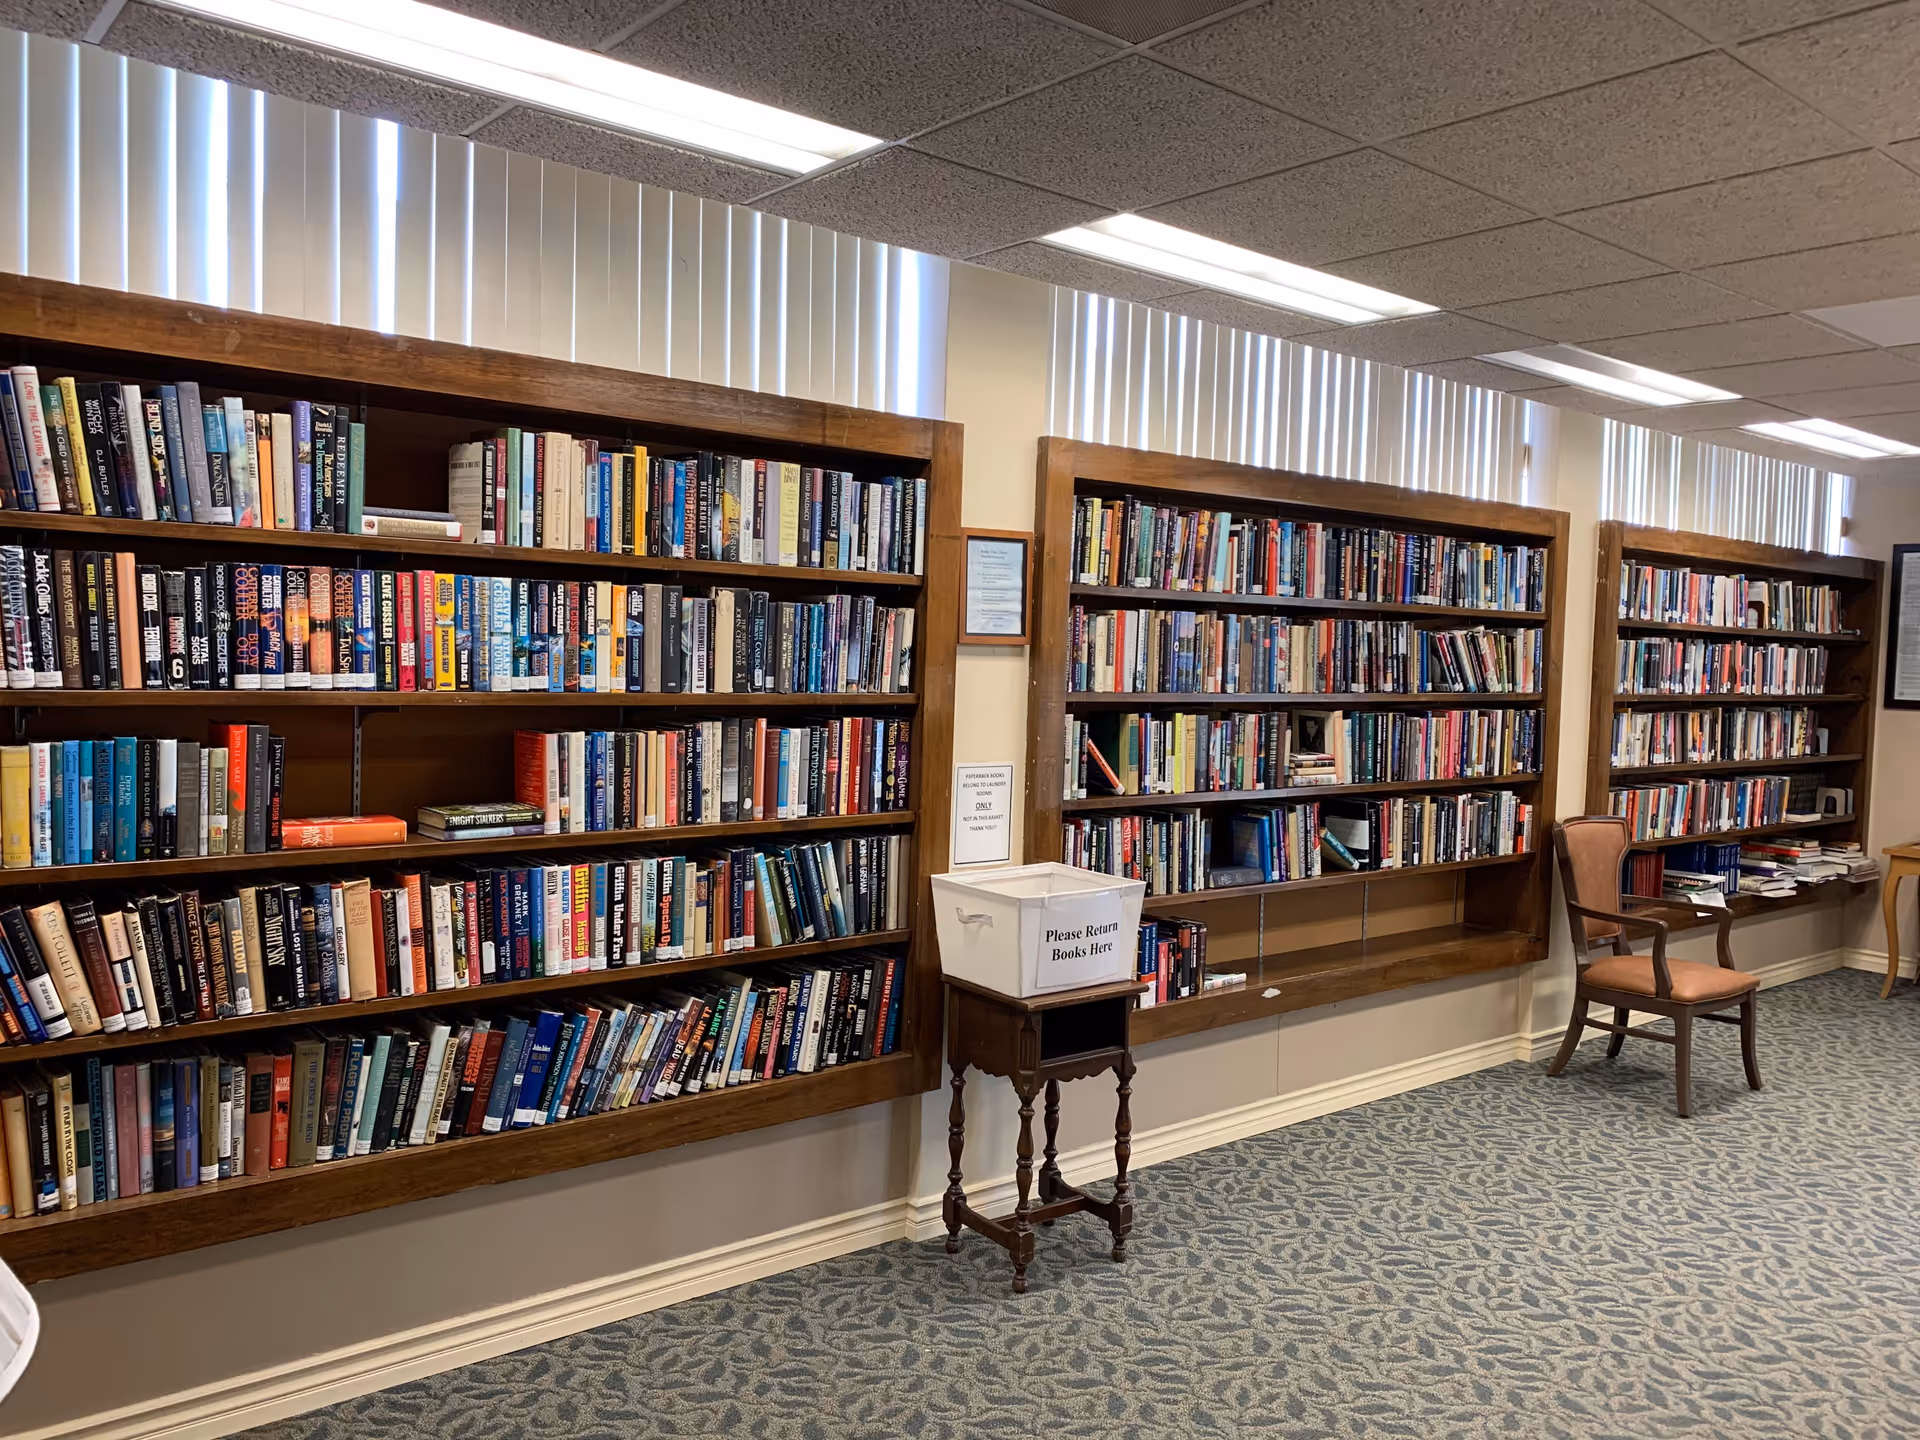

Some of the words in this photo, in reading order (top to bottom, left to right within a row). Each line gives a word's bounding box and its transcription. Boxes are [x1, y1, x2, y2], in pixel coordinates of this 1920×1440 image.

[23, 381, 36, 400] LONG
[49, 394, 59, 406] THE
[28, 405, 40, 423] TIME
[52, 408, 63, 435] TUSCAN
[85, 400, 96, 434] WINTER
[93, 399, 103, 434] WITCHY
[146, 404, 161, 432] BLIND
[32, 425, 45, 456] LEAVING
[56, 437, 67, 457] CHILD
[152, 435, 165, 456] SIDE
[324, 453, 334, 465] The
[336, 436, 345, 505] REDEEMER
[324, 465, 333, 497] Americans
[33, 551, 50, 583] Jackie
[61, 559, 71, 573] THE
[104, 558, 113, 586] MICHAEL
[216, 565, 224, 588] ROBIN
[62, 575, 73, 598] BRASS
[141, 574, 157, 593] ROBIN
[194, 576, 202, 600] ROBIN
[235, 568, 249, 621] COULTER
[262, 575, 273, 609] COULTER
[273, 575, 281, 609] CATHERINE
[334, 575, 345, 618] COULTER
[382, 574, 391, 599] CLIVE
[36, 583, 51, 614] Collins
[106, 588, 115, 620] CONNELLY
[143, 594, 158, 611] COOK
[217, 590, 225, 612] COOK
[668, 592, 678, 618] Scarpetta
[64, 599, 74, 629] VERDICT
[382, 600, 392, 638] CUSSLER
[71, 637, 79, 666] MICHAEL
[109, 636, 117, 669] OVERLOOK
[191, 636, 200, 665] SIGNS
[217, 631, 228, 673] SEIZURE
[237, 637, 248, 664] OUT
[249, 634, 259, 667] BLOW
[269, 631, 280, 652] BACK
[401, 643, 409, 666] DEATH
[264, 651, 276, 669] FIRE
[622, 789, 631, 816] GARDEN
[452, 815, 476, 826] NIGHT
[548, 871, 557, 895] GRIFFIN
[613, 866, 625, 901] Griffin
[733, 879, 743, 908] Garwood
[186, 896, 198, 928] VINCE
[244, 895, 255, 942] MANTISSA
[500, 897, 508, 937] GARDNER
[613, 903, 624, 936] Under
[131, 921, 144, 952] FRASER
[190, 930, 201, 960] FLYNN
[264, 915, 284, 948] NIGHT
[293, 932, 301, 951] LOST
[576, 920, 588, 957] Hostage
[1045, 926, 1082, 942] Please
[1086, 921, 1118, 938] Return
[231, 929, 246, 974] FALLOUT
[267, 946, 286, 966] SKY
[336, 927, 345, 966] DEBUNKERY
[613, 937, 622, 960] Fire
[1051, 945, 1087, 961] Books
[1090, 940, 1113, 956] Here
[39, 981, 55, 1011] TRUST
[199, 976, 207, 990] LAST
[296, 966, 305, 998] WANTED
[832, 971, 841, 995] DEAN
[201, 991, 209, 1006] MAN
[726, 990, 739, 1021] PARTNER
[827, 996, 837, 1030] KOONTZ
[672, 1039, 685, 1059] DEAD
[719, 1027, 730, 1048] CRIME
[233, 1069, 244, 1095] Victoria
[347, 1052, 360, 1087] FLAGS
[233, 1096, 244, 1109] Holt
[344, 1090, 354, 1105] OF
[40, 1125, 48, 1141] JAMES
[93, 1116, 103, 1156] WORLD
[338, 1108, 352, 1148] PROFIT
[95, 1161, 105, 1195] ATLAS
